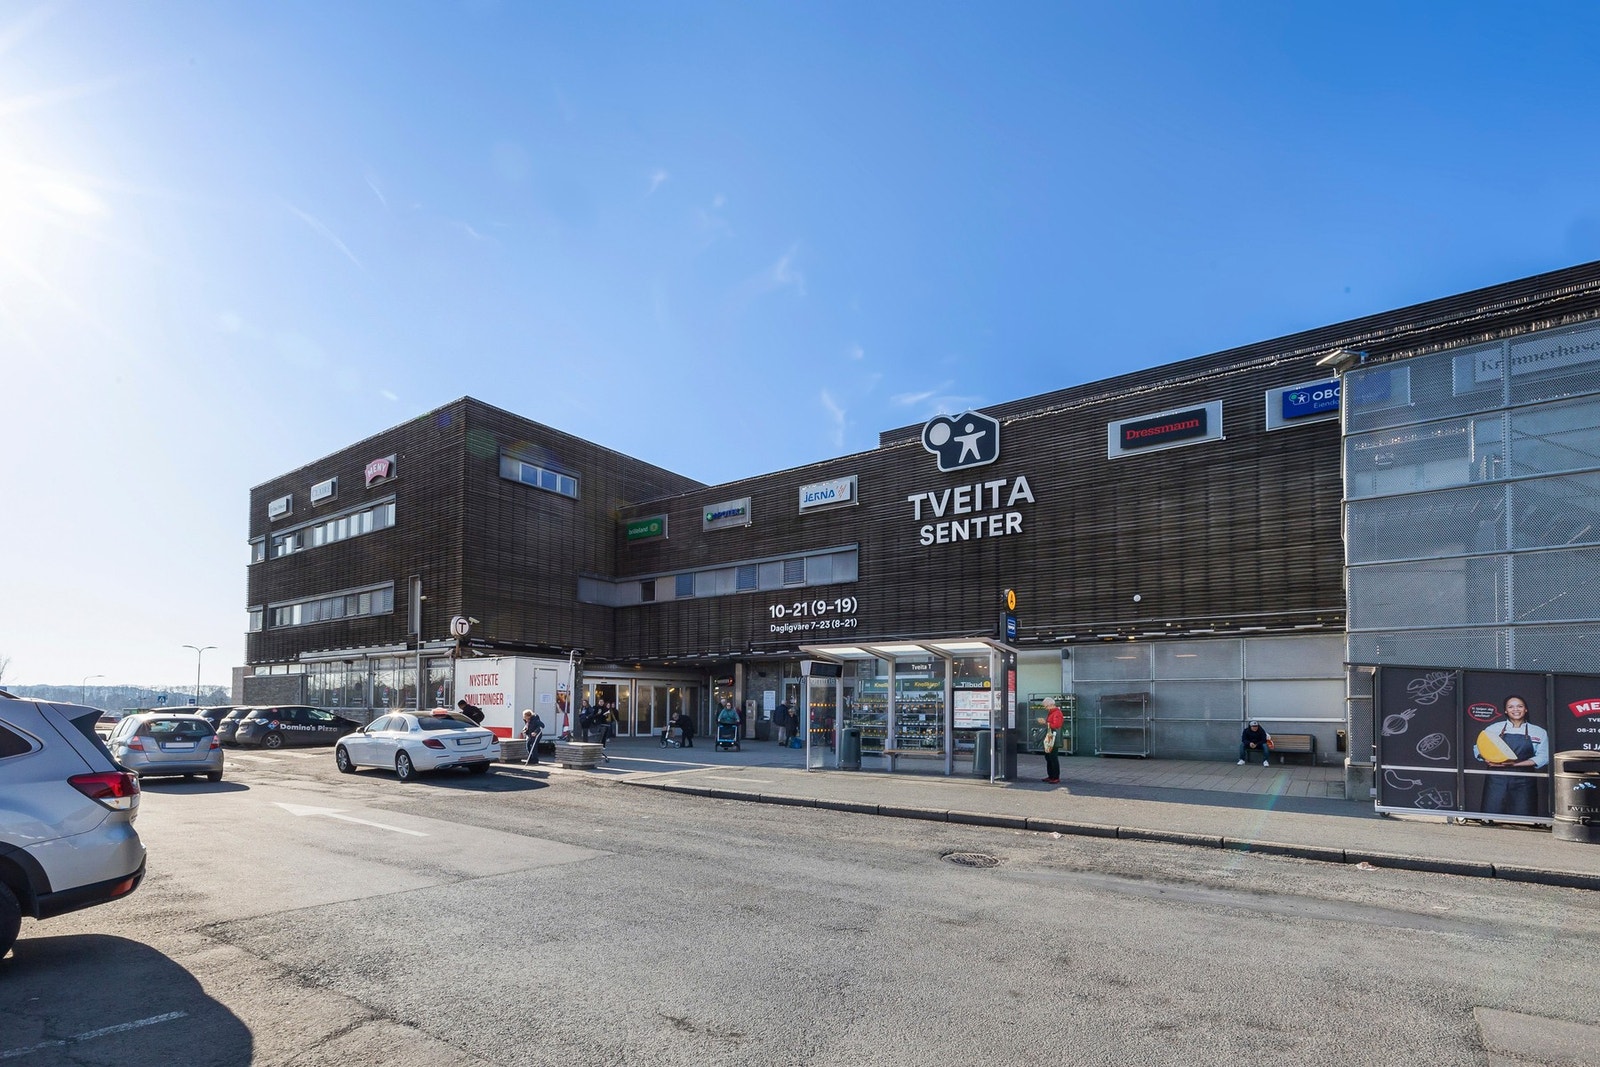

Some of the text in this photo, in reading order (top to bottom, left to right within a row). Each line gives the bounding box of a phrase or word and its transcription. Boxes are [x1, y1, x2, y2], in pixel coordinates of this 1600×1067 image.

[1481, 341, 1600, 371] Krmmerhuse
[1312, 387, 1340, 401] OBO
[1314, 399, 1339, 409] Eiendo
[1126, 418, 1199, 440] Dressmann
[367, 463, 386, 477] MENY
[907, 475, 1035, 521] TVEITA
[920, 511, 1023, 546] SENTER
[769, 596, 858, 619] 10-21 (9-19)
[459, 622, 466, 633] T
[770, 618, 858, 634] Dagligvare 7-23 (8-21)
[469, 673, 499, 686] NYSTEKTE
[465, 693, 504, 706] SMULTRINGER
[1575, 702, 1600, 713] ME
